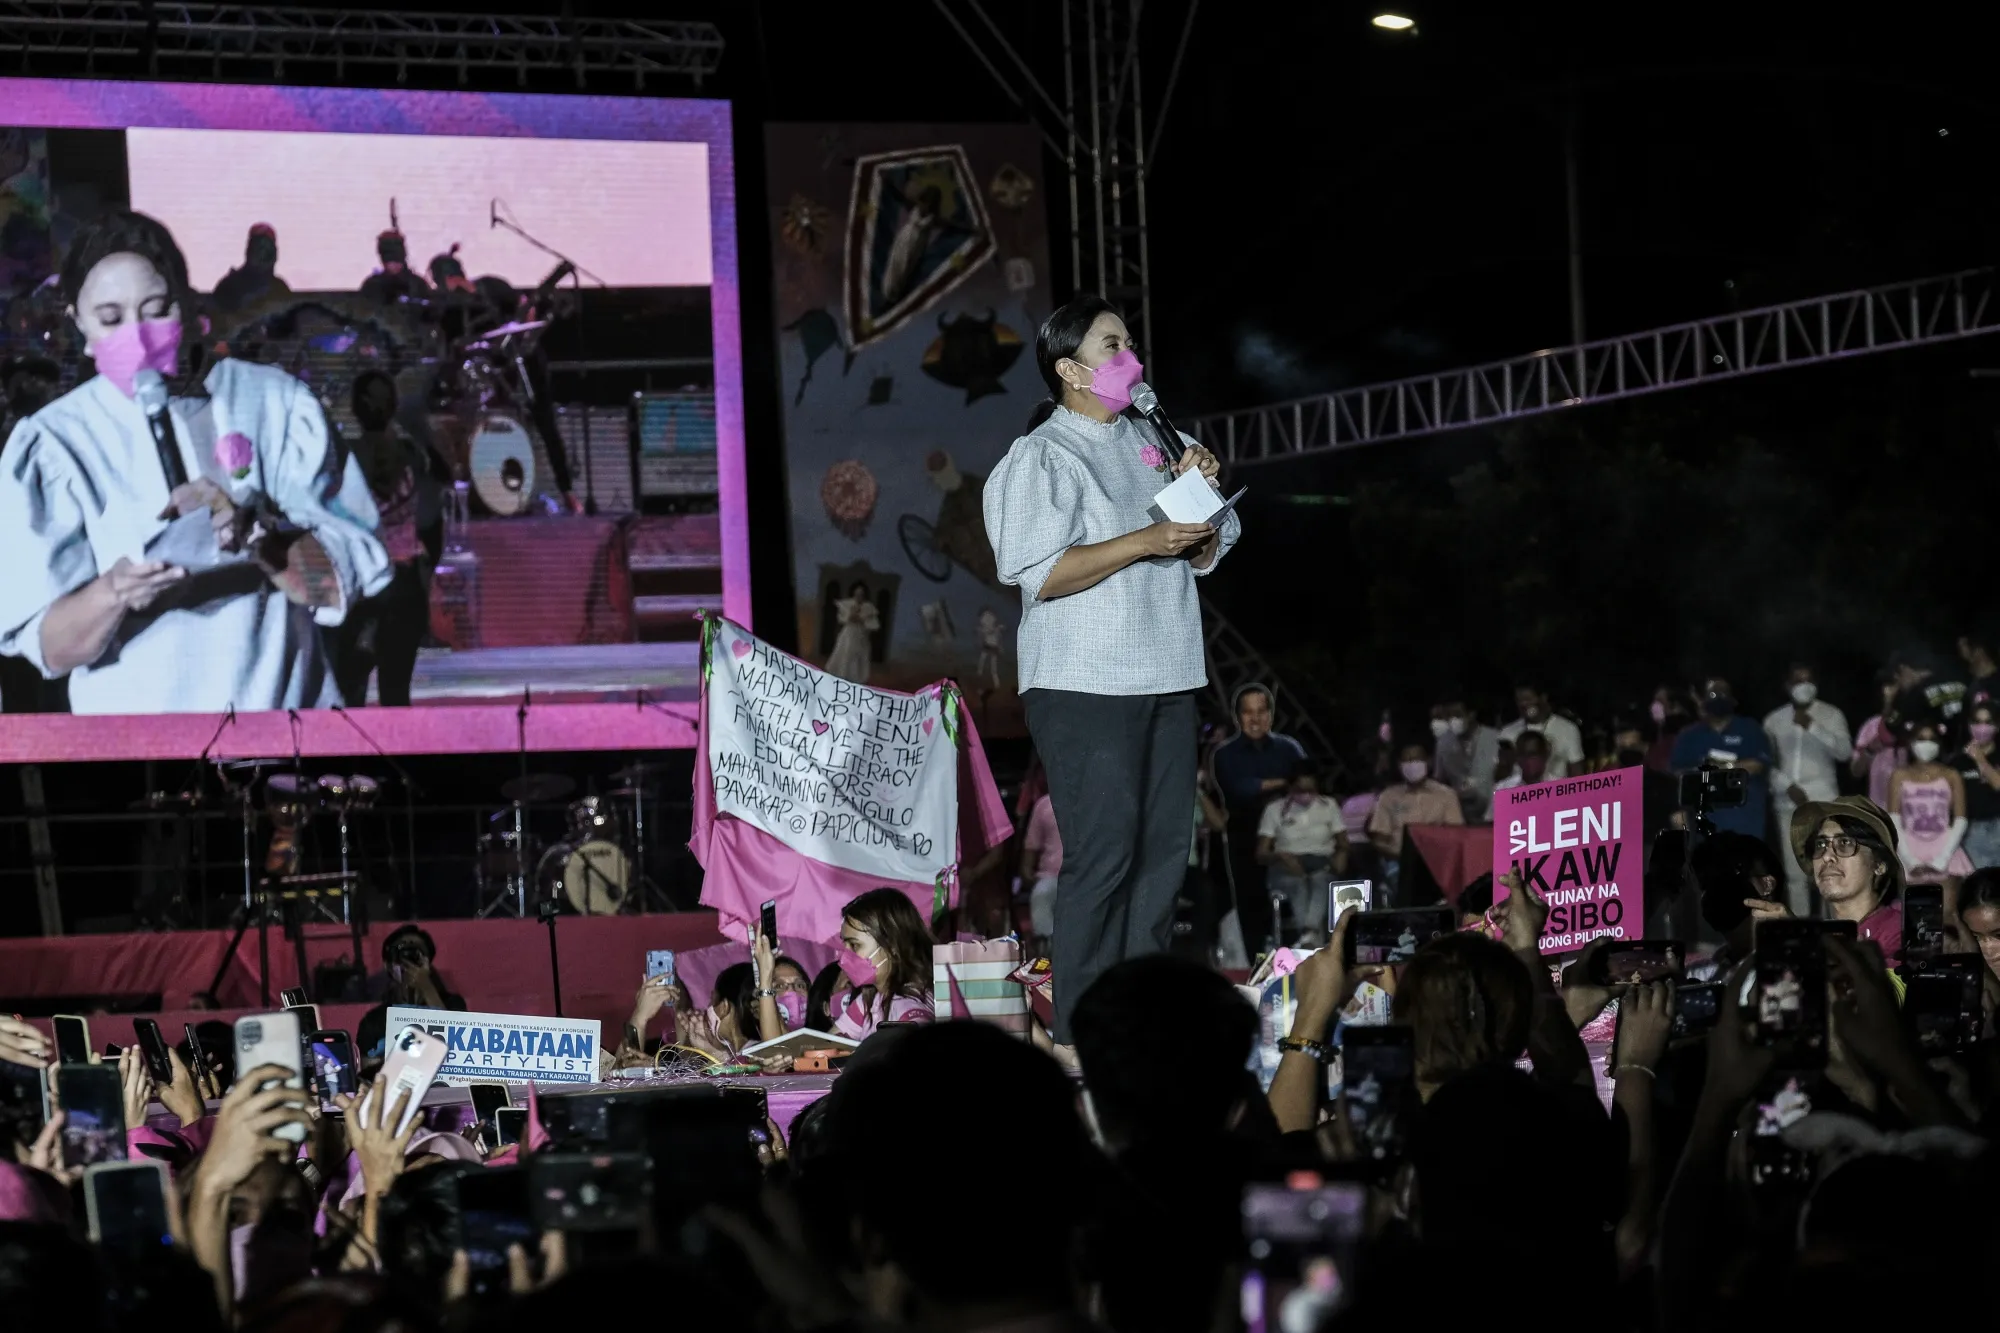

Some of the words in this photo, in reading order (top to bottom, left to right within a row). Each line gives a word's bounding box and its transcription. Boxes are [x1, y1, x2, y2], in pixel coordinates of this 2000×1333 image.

[751, 639, 824, 693] HAPPY
[833, 680, 932, 723] BIRTHDAY
[737, 663, 809, 709] MADAM
[818, 699, 849, 721] VP
[858, 713, 921, 744] LENI
[734, 704, 818, 761] FINANCIAL
[826, 747, 918, 786] LITERACY
[894, 746, 925, 767] THE
[714, 752, 768, 786] MAHAL
[772, 771, 828, 804] NAMING
[754, 738, 874, 797] EDUCATORS
[1511, 787, 1552, 804] HAPPY
[1556, 775, 1622, 796] BIRTHDAY!
[714, 775, 793, 822] PAYAKAP
[913, 832, 932, 857] PO
[1528, 801, 1621, 853] LENI
[1510, 820, 1527, 855] VP
[1511, 843, 1622, 891] KAW
[1545, 886, 1595, 906] TUNAY
[1598, 882, 1620, 899] NA
[1542, 898, 1623, 936] SIBO
[1538, 934, 1572, 949] UONG
[446, 1052, 592, 1071] PARTYLIST
[448, 1026, 593, 1059] KABATAAN
[465, 1069, 506, 1077] KALUSUGAN,
[507, 1070, 539, 1079] TRABAHO,
